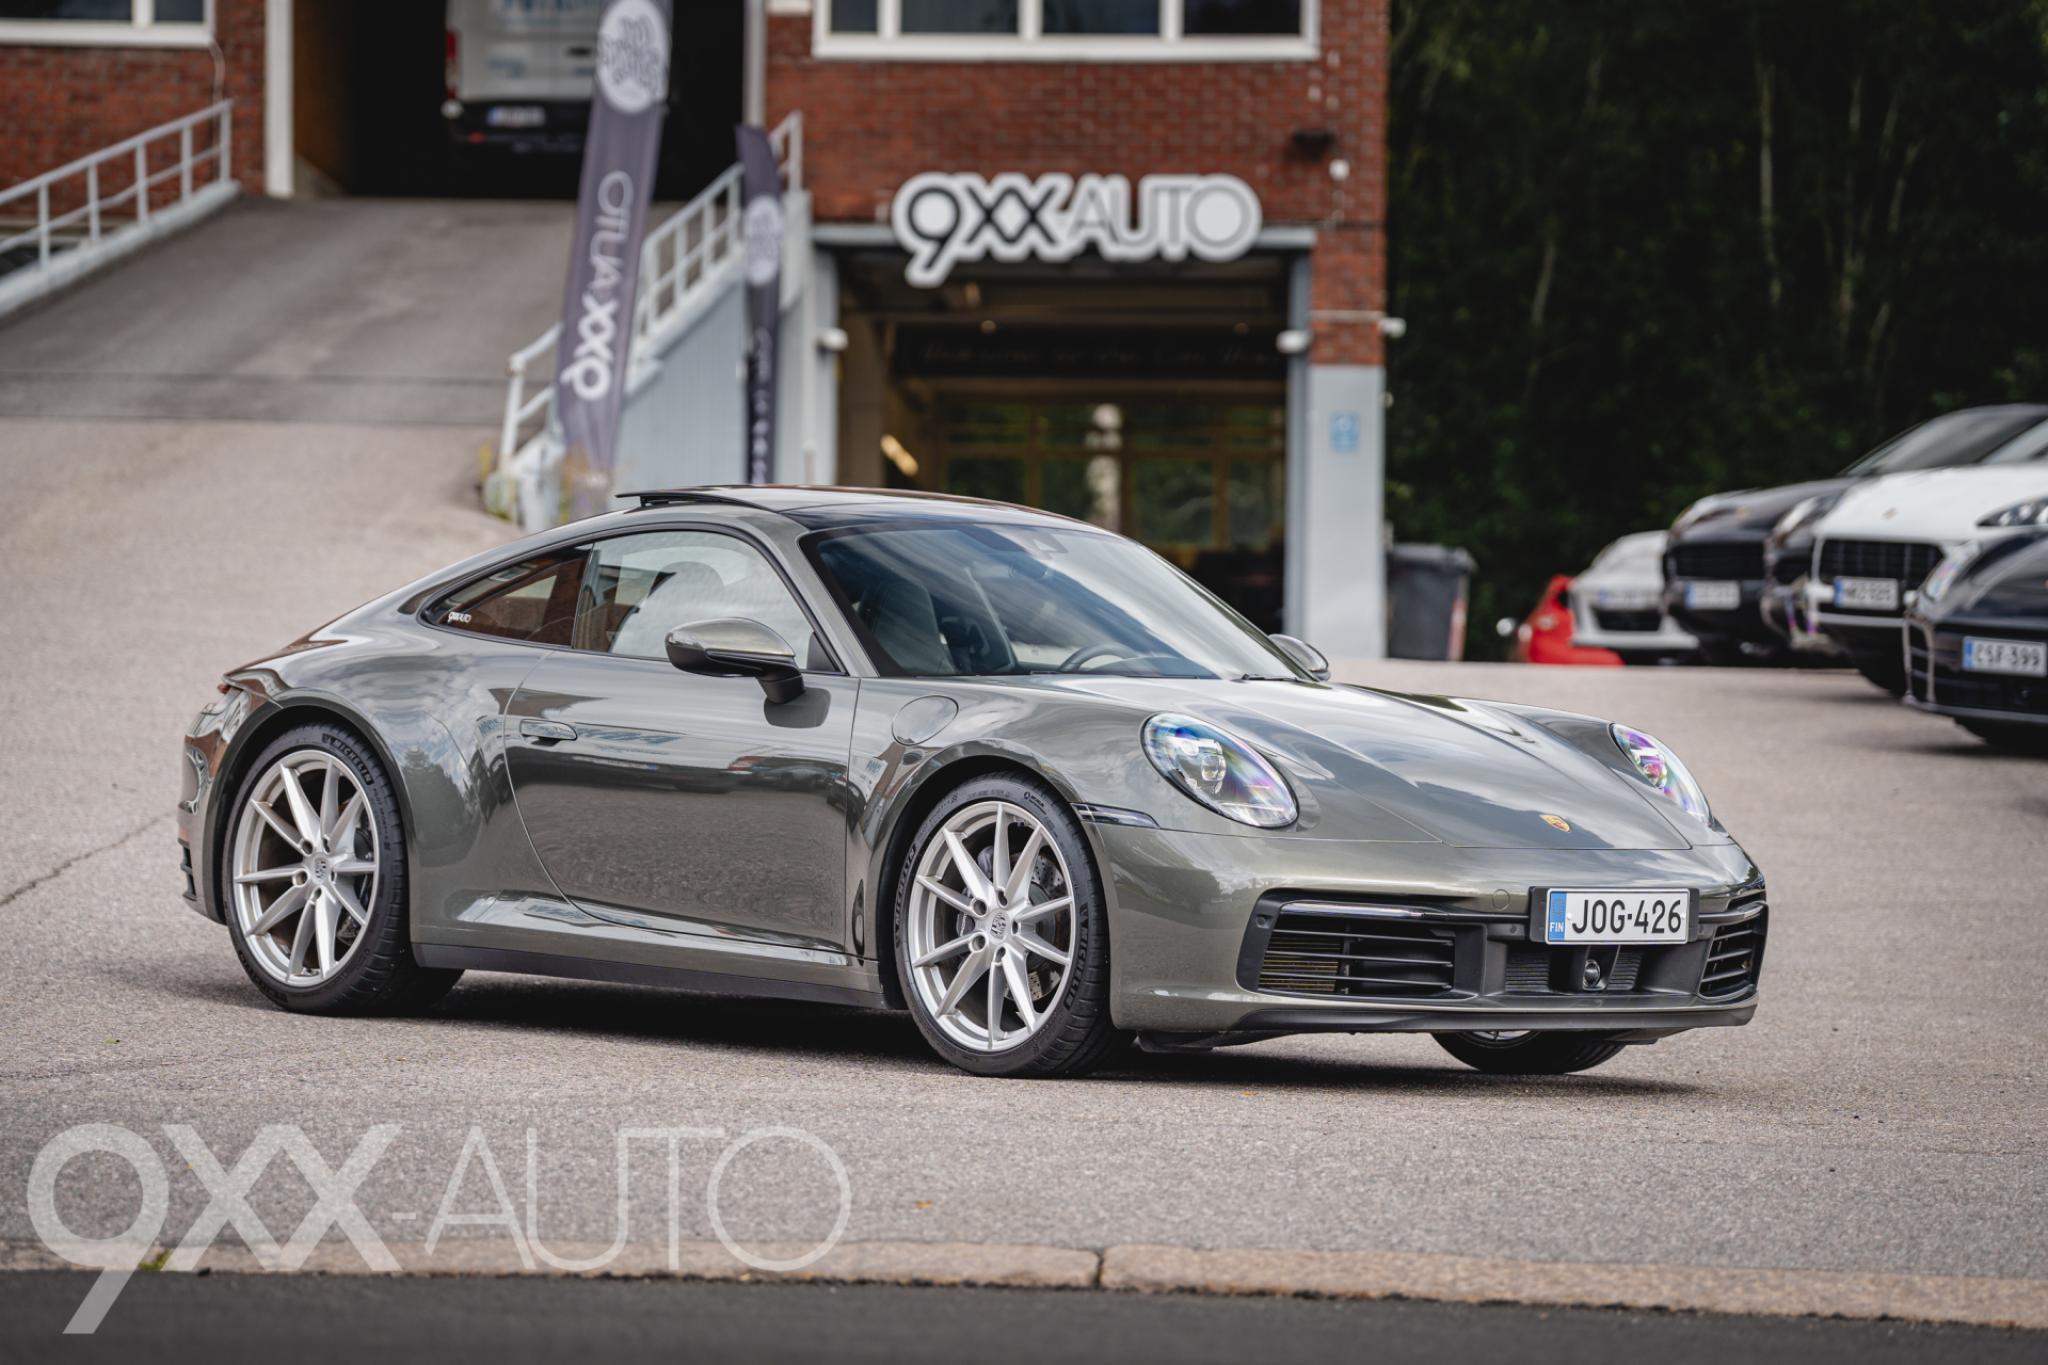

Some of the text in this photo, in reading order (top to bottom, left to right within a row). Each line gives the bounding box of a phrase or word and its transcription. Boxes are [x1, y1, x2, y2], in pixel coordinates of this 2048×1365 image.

[332, 738, 373, 784] MICHELIN
[1549, 921, 1564, 933] FIN
[1571, 898, 1682, 934] JOG-426
[1065, 926, 1089, 1006] MICHELIN
